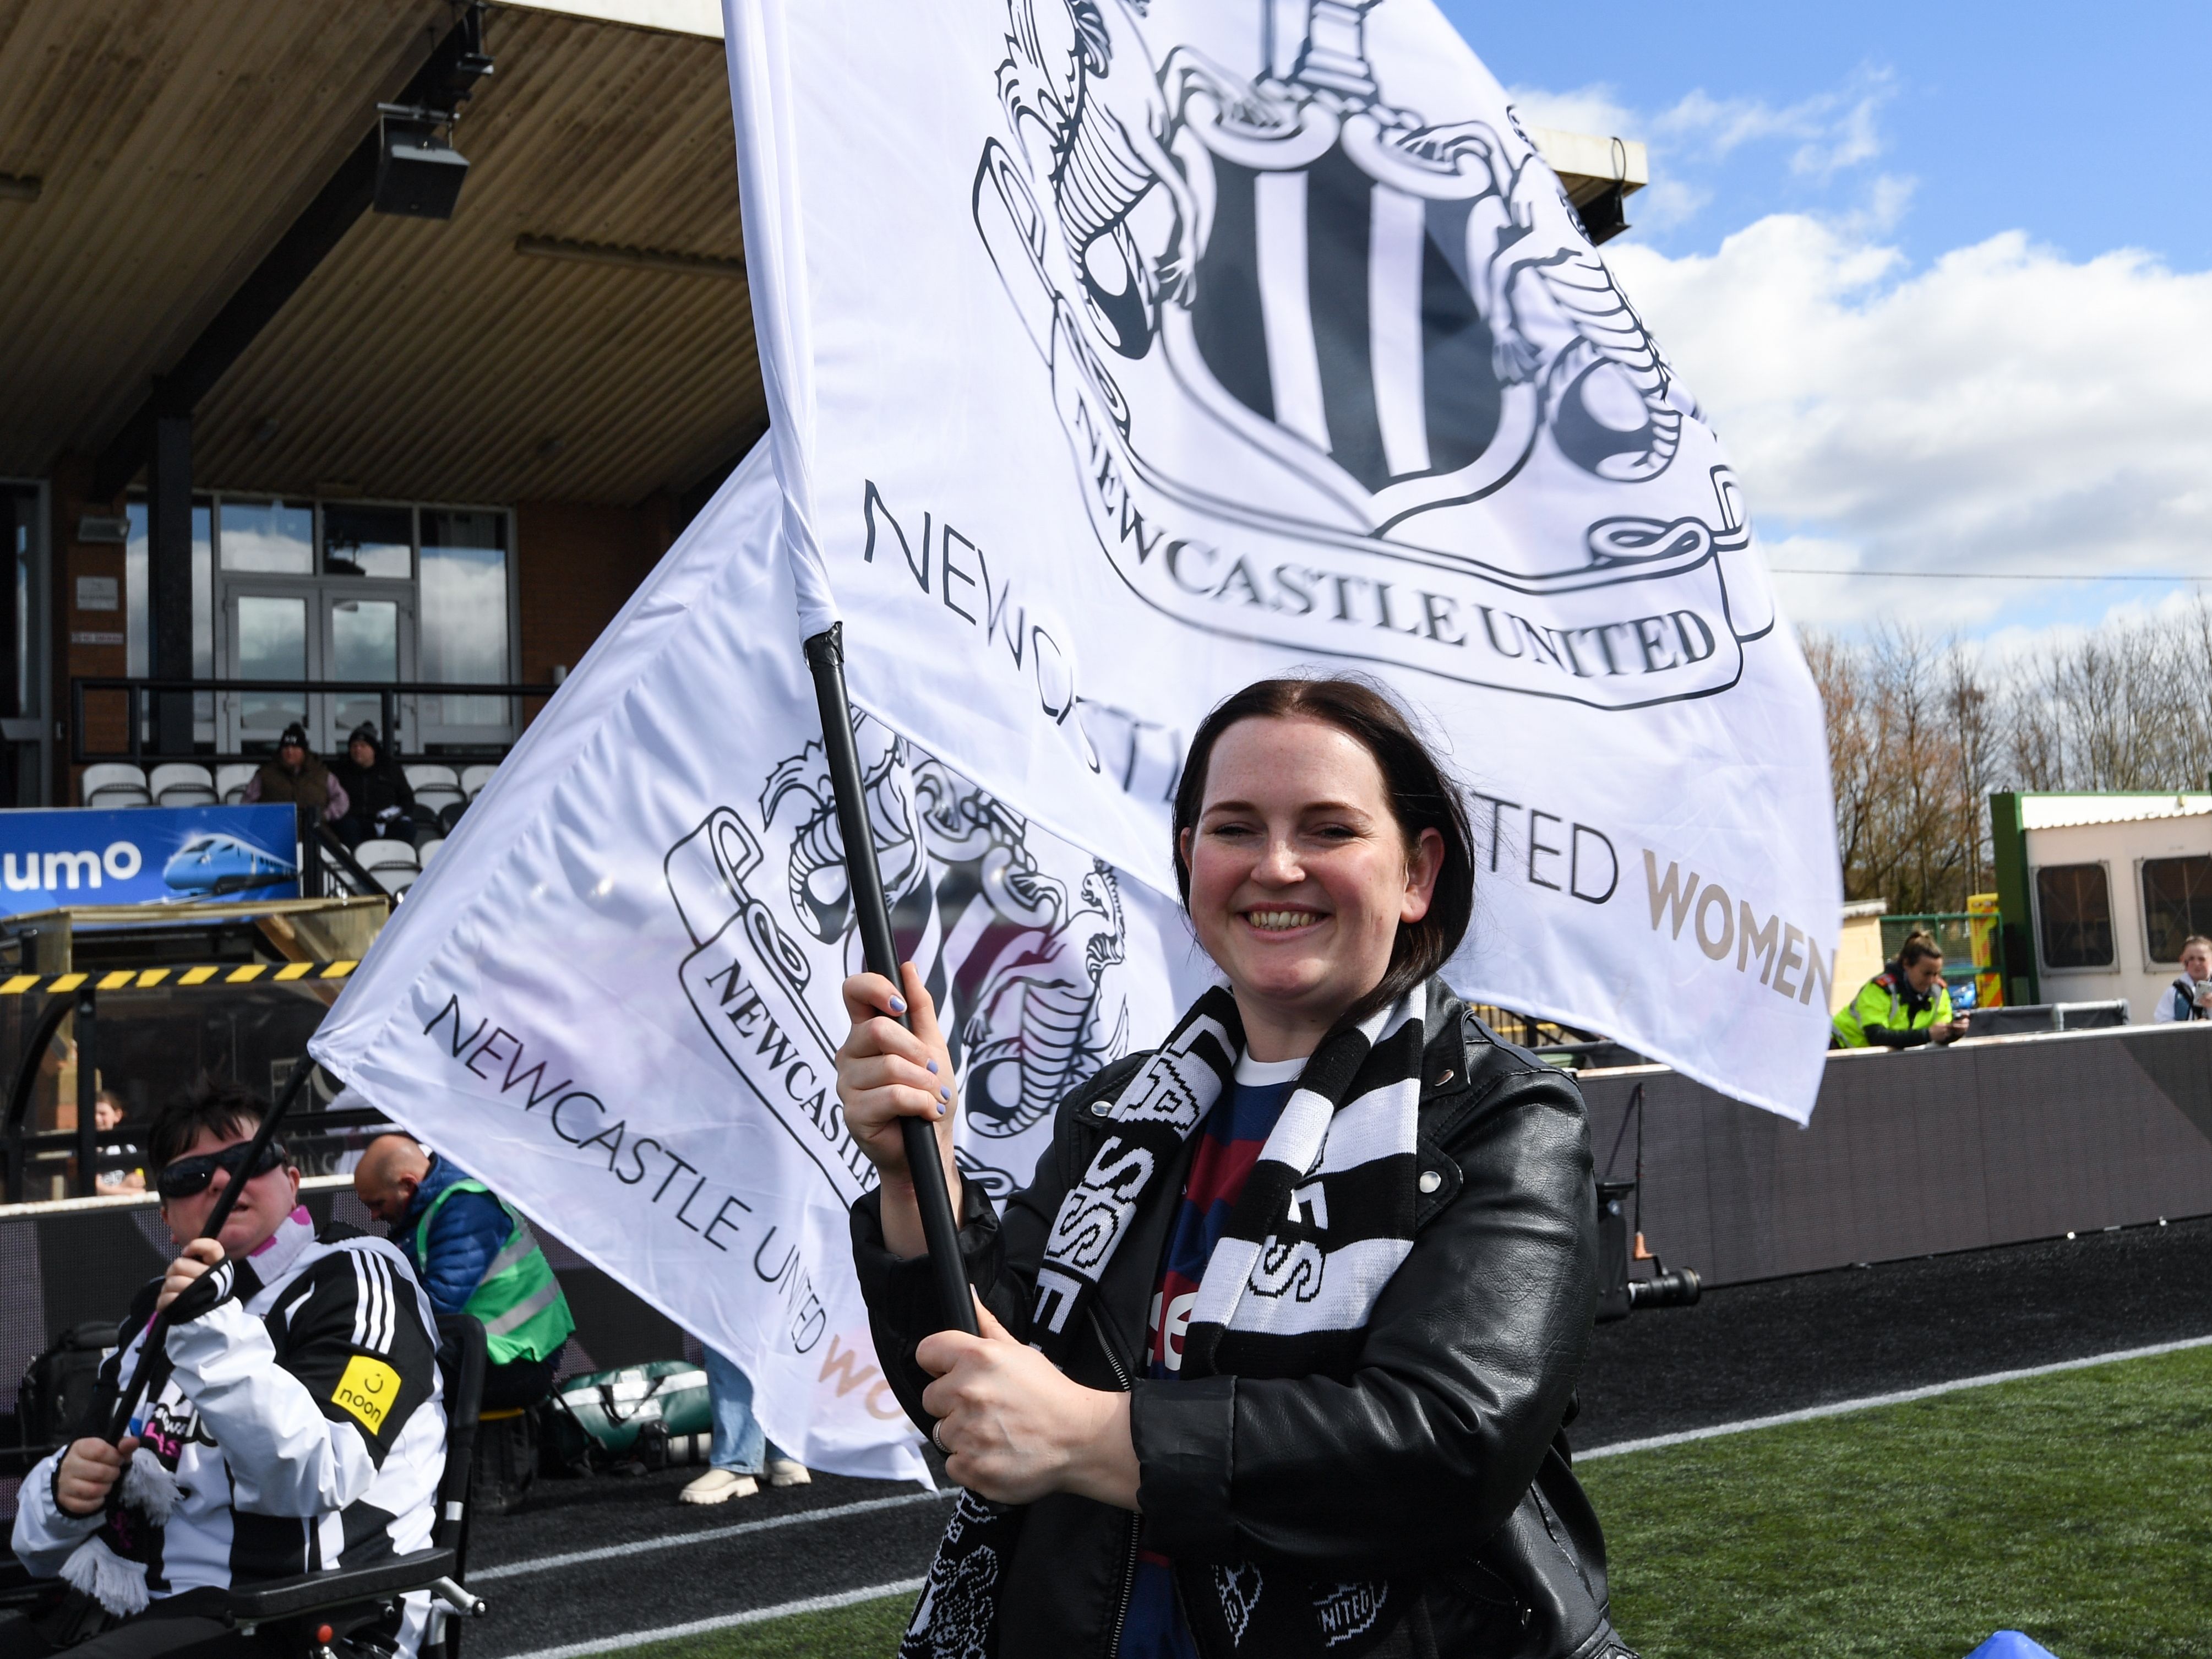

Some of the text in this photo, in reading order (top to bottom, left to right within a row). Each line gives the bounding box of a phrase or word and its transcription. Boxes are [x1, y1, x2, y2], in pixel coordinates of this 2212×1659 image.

[1076, 387, 1716, 677] NEWCASTLE UNITED
[0, 841, 142, 892] umo
[1471, 792, 1619, 905] TED
[1643, 848, 1835, 1016] WOMEN
[423, 993, 753, 1252] NEWCASTLE
[339, 1388, 381, 1423] noon
